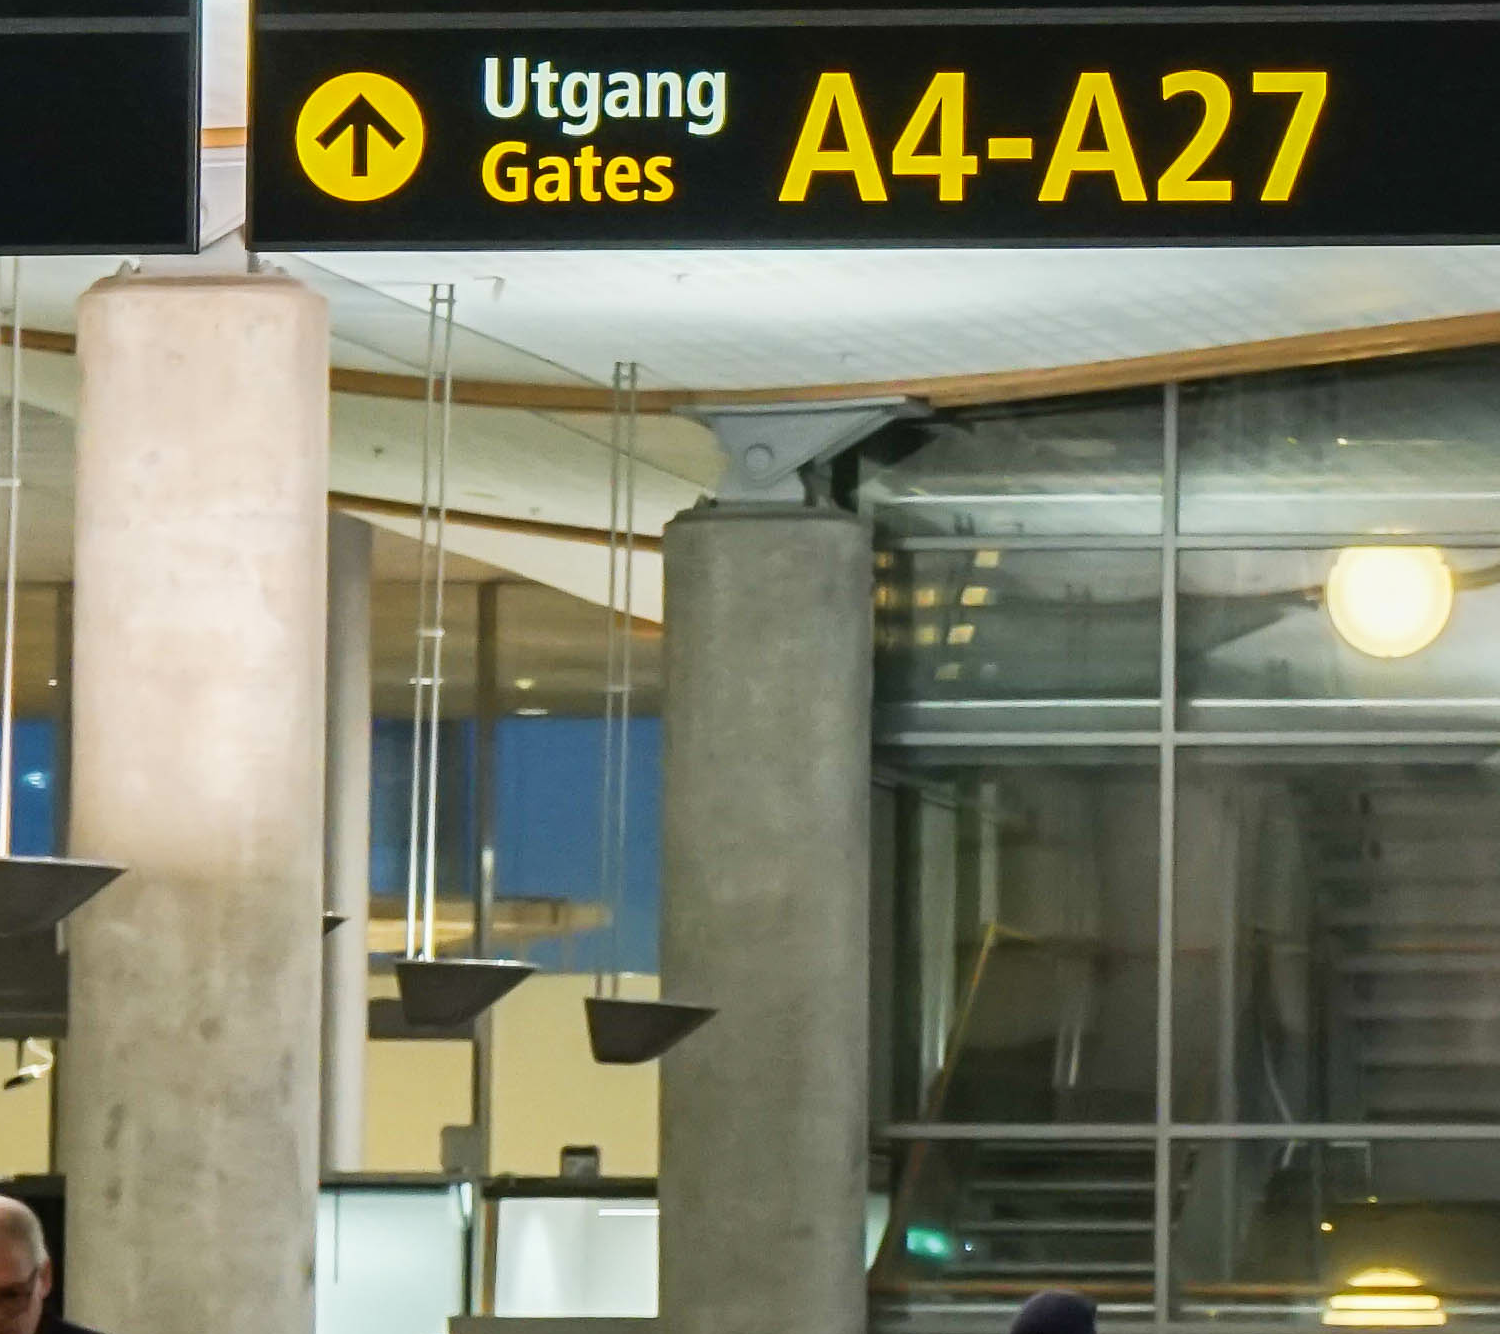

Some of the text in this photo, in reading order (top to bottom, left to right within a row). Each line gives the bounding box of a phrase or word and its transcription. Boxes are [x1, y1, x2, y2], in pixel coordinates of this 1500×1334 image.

[483, 57, 726, 136] Utgang
[779, 70, 1328, 202] A4-A27
[482, 141, 675, 203] Gates
